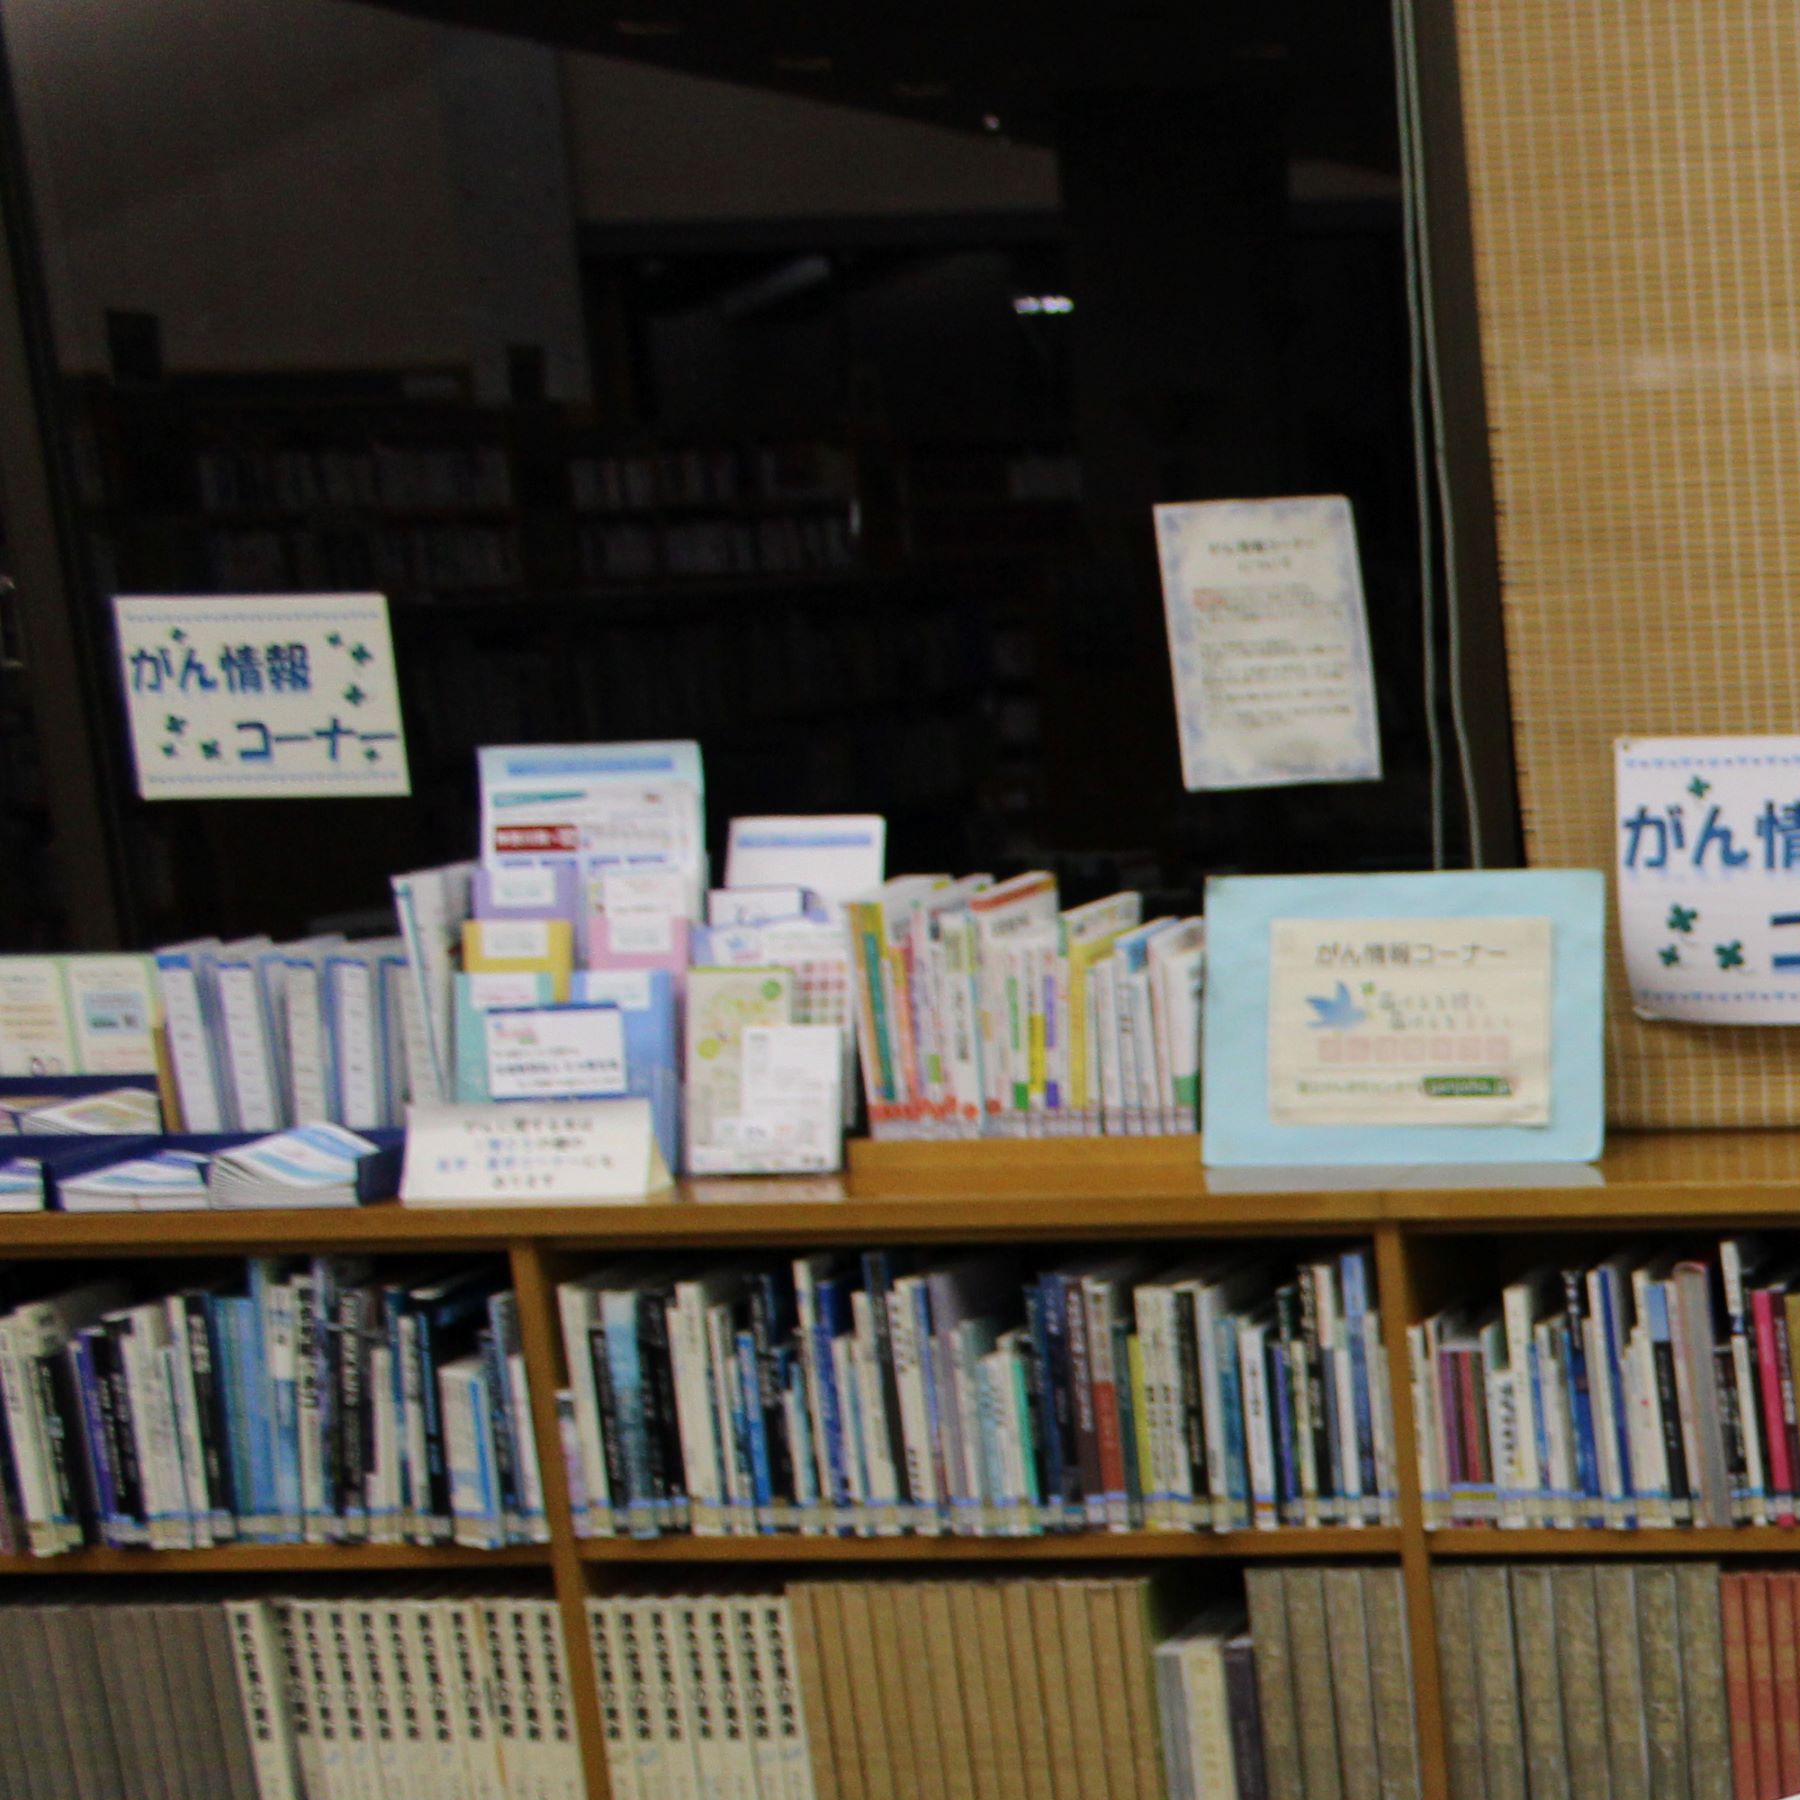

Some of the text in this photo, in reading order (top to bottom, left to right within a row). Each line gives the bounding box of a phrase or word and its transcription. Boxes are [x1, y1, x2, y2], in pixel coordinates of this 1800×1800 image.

[130, 645, 311, 695] がん情報
[237, 719, 398, 764] コーナー
